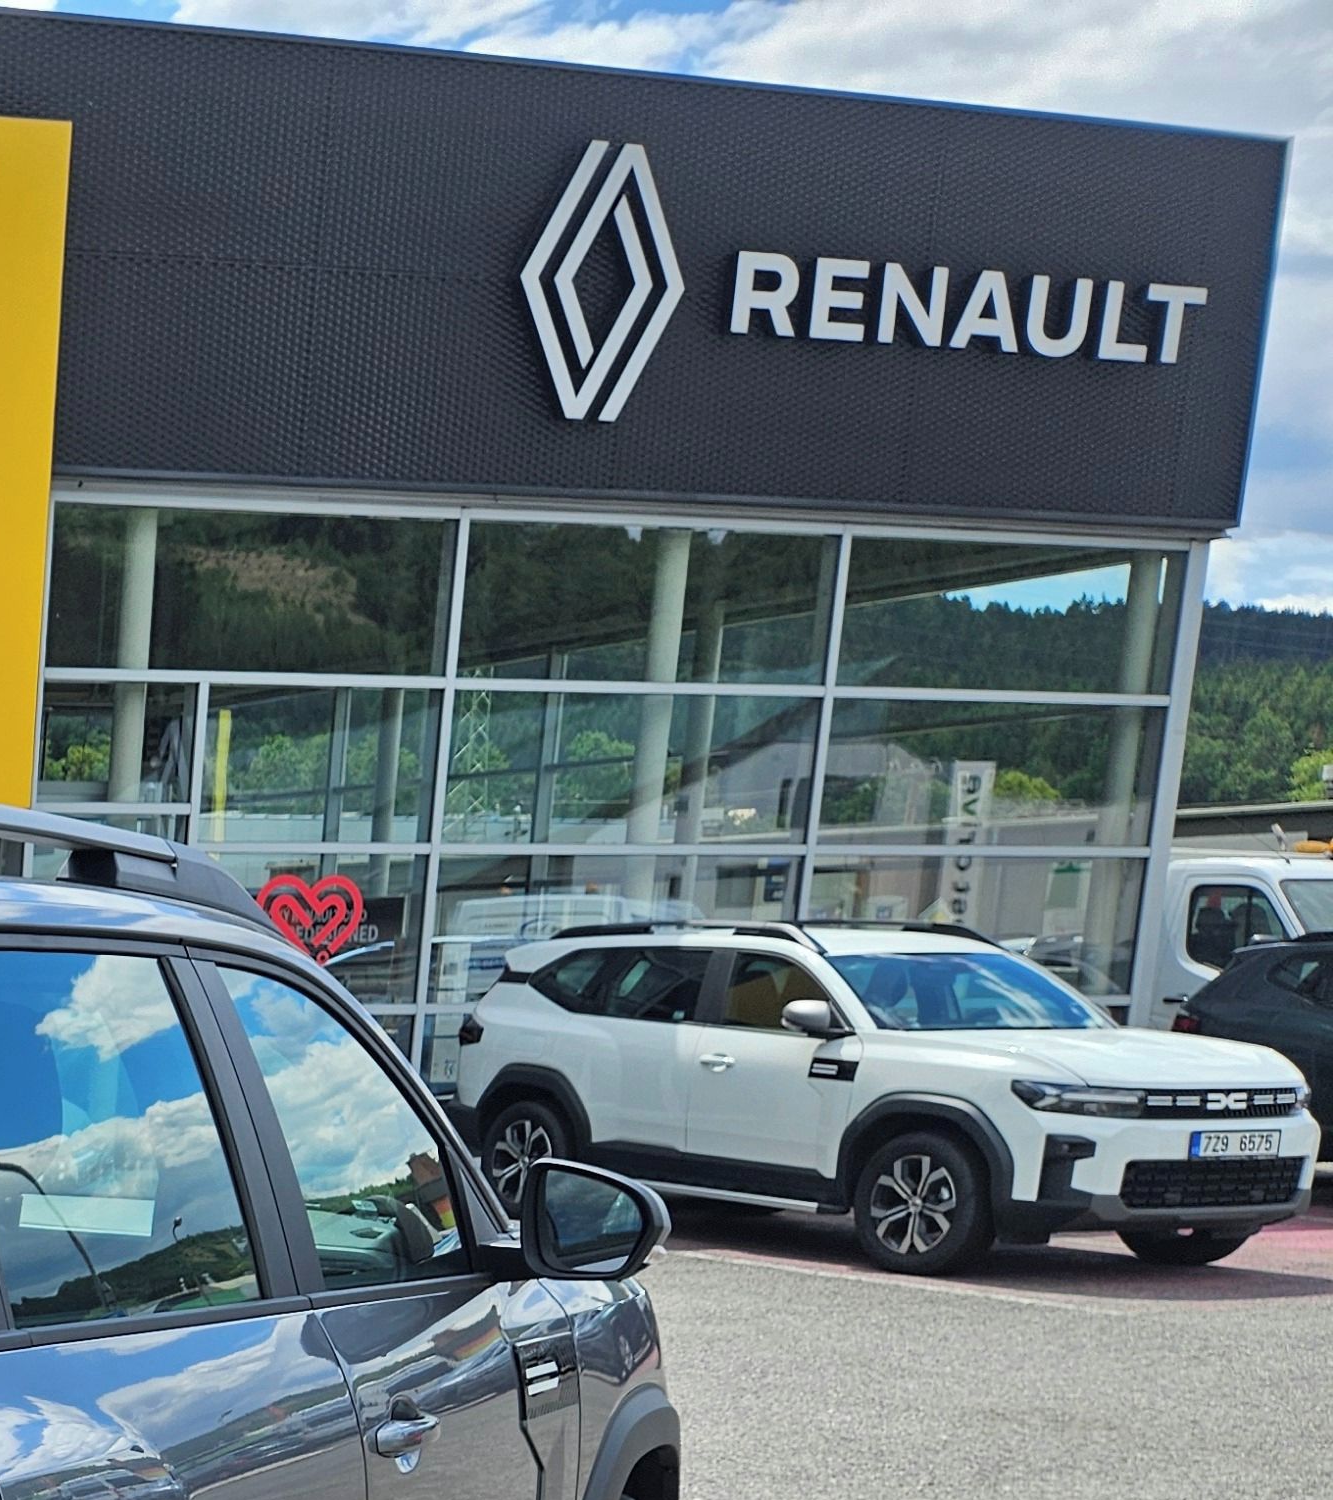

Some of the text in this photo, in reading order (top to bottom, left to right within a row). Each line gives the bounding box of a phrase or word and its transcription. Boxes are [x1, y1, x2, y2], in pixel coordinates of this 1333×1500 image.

[730, 249, 1209, 365] RENAULT
[1204, 1133, 1273, 1153] 7Z9 6575
